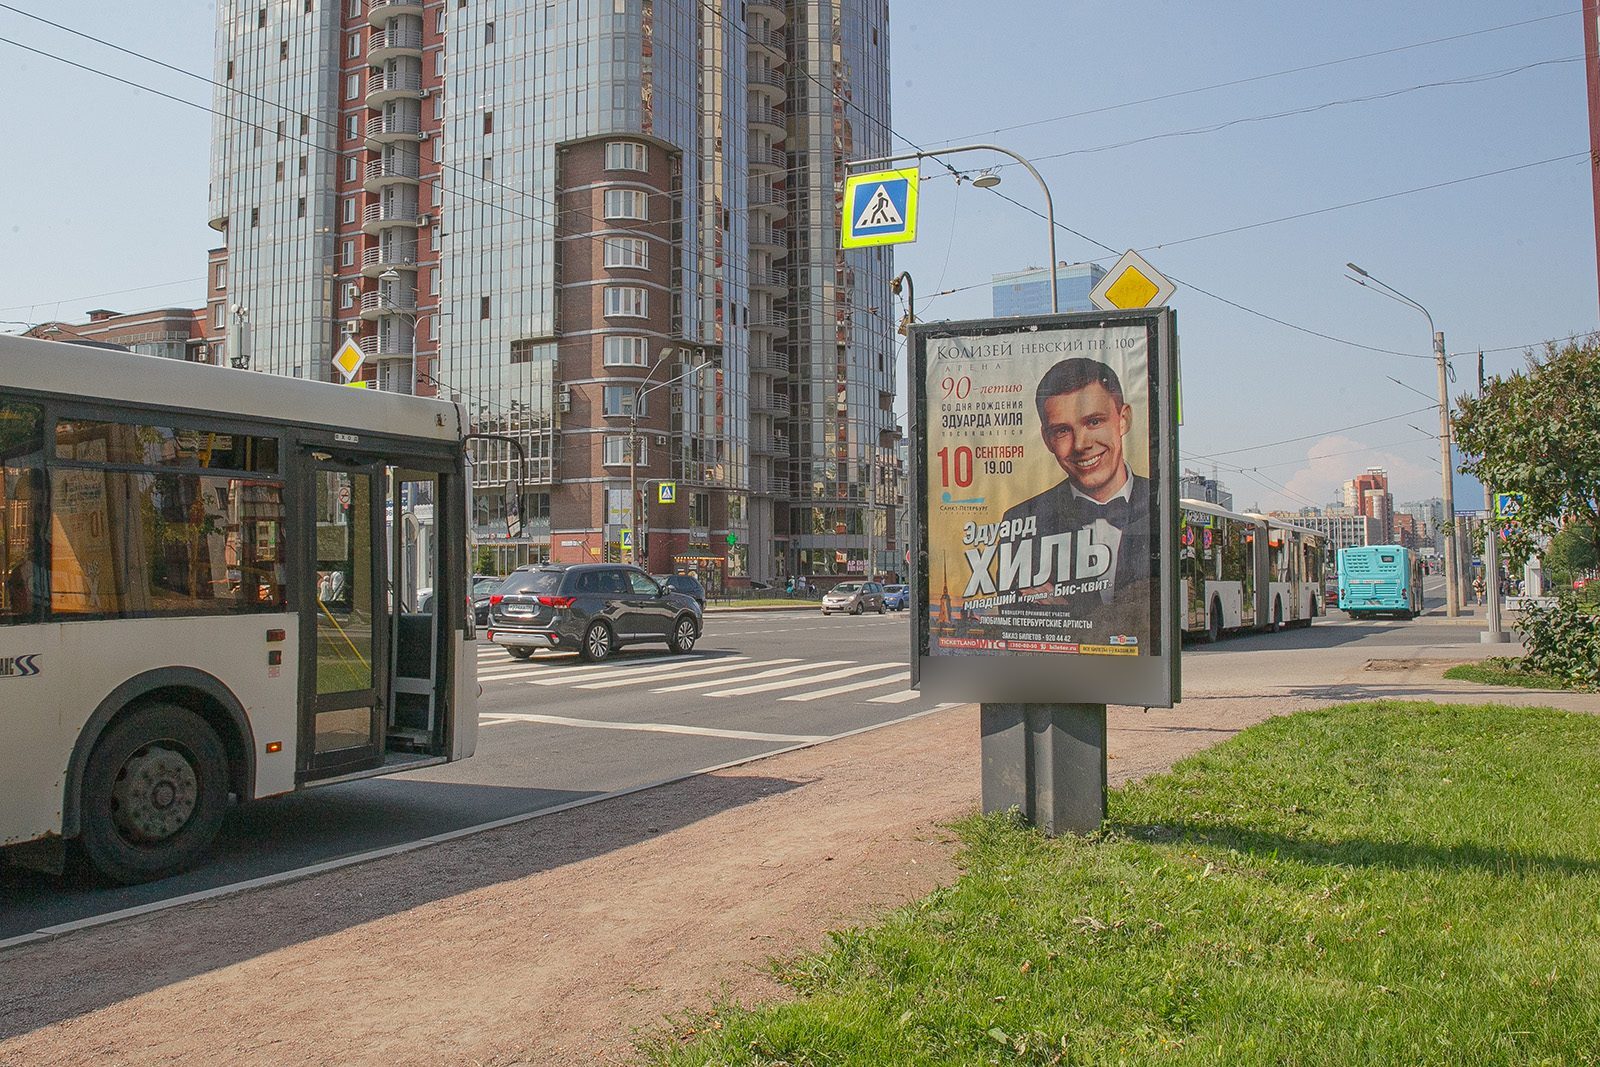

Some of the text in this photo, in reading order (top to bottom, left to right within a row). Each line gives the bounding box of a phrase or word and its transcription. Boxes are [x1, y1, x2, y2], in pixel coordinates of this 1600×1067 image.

[1021, 339, 1083, 354] НЕВСКИЙ
[1115, 338, 1135, 349] 100
[944, 363, 1001, 373] АРЕНА
[941, 400, 1023, 412] СО ДНЯ РОЖДЕНИЯ
[942, 412, 1023, 429] ЭДУАРДА ХИЛЯ
[937, 446, 1024, 487] 10 СЕНТЯБРЯ
[984, 461, 1013, 474] 19.00
[962, 515, 1037, 545] Эдуард
[962, 528, 1111, 598] ХИЛЬ
[964, 590, 1016, 611] младший
[1023, 592, 1048, 603] группа
[979, 616, 1093, 629] ЛЮБИМЫЕ ПЕТЕРБУРГСКИЕ АРТИСТЫ
[1002, 632, 1018, 640] ЗАКАЗ
[1019, 632, 1041, 641] БИЛЕТОВ
